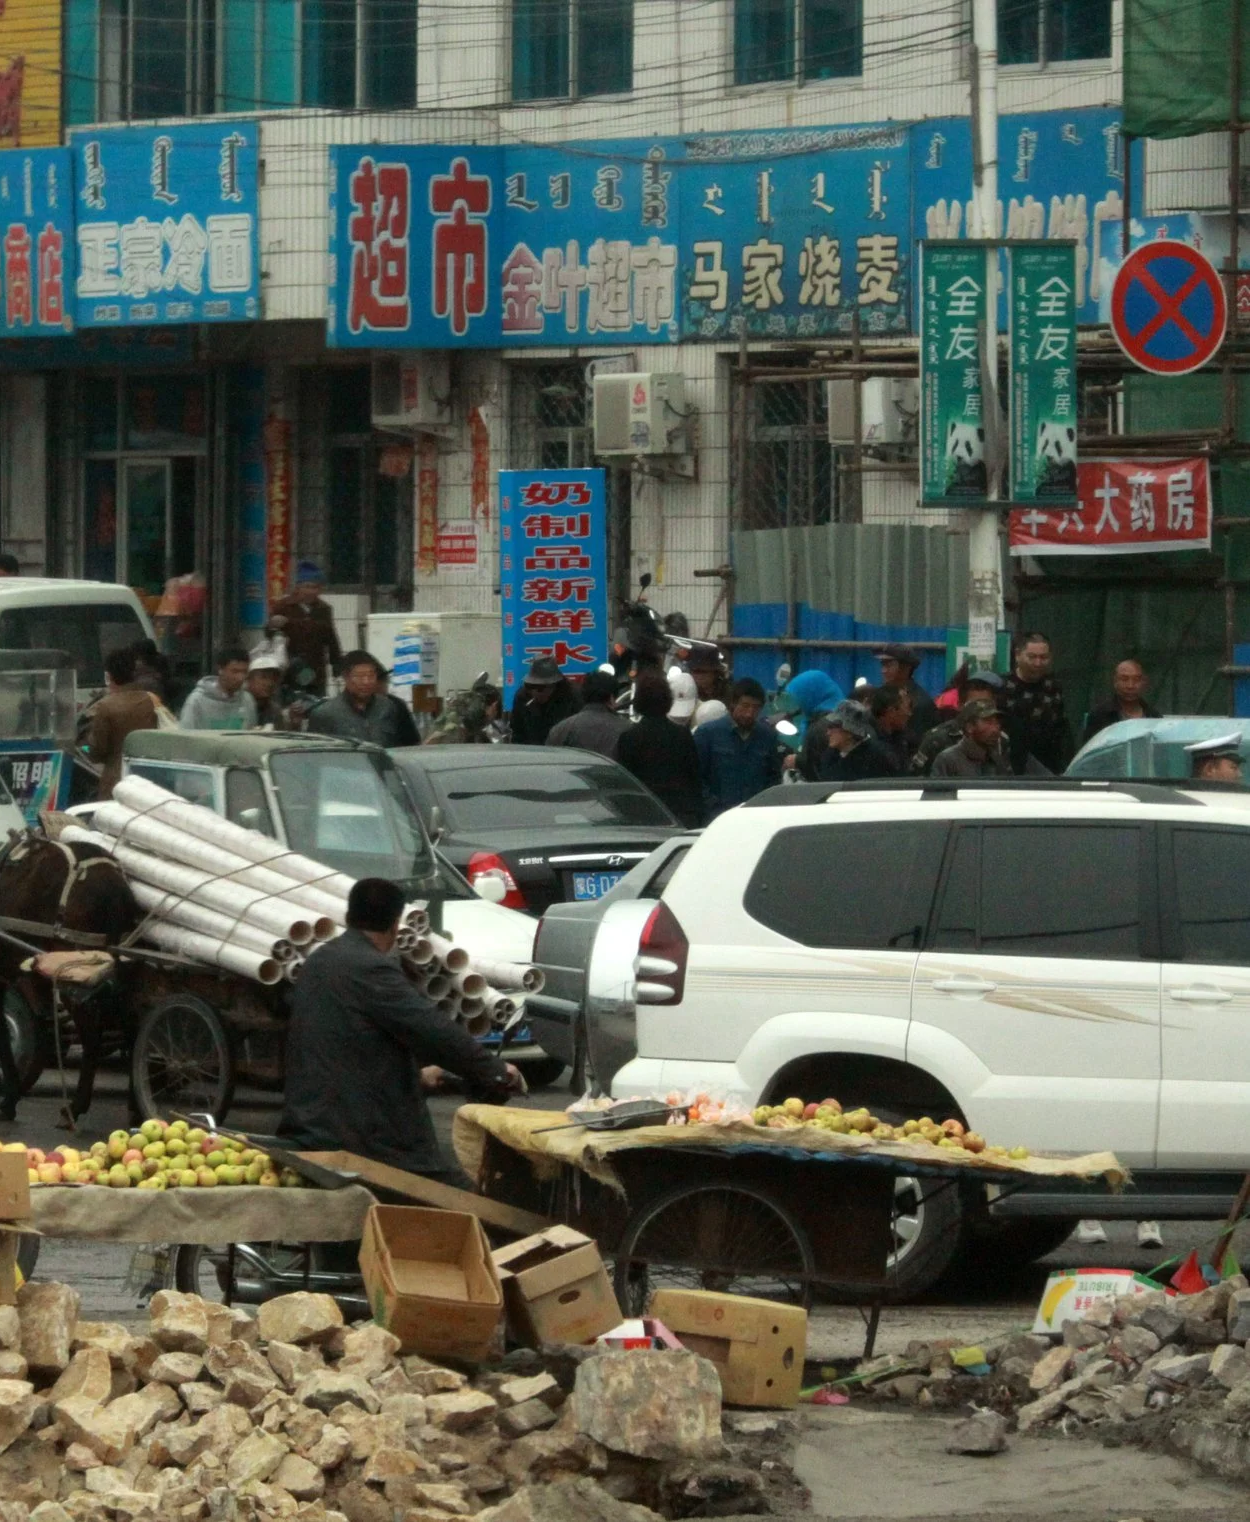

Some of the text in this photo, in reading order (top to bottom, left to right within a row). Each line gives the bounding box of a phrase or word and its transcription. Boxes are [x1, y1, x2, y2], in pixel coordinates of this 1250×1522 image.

[77, 213, 252, 299] 正宗冷面
[348, 156, 491, 336] 超市
[502, 237, 677, 335] 金叶超市
[689, 234, 900, 311] 马家烧麦
[944, 275, 983, 417] 全友家居
[1035, 276, 1072, 417] 全友家居
[520, 481, 596, 683] 奶制品新鲜水
